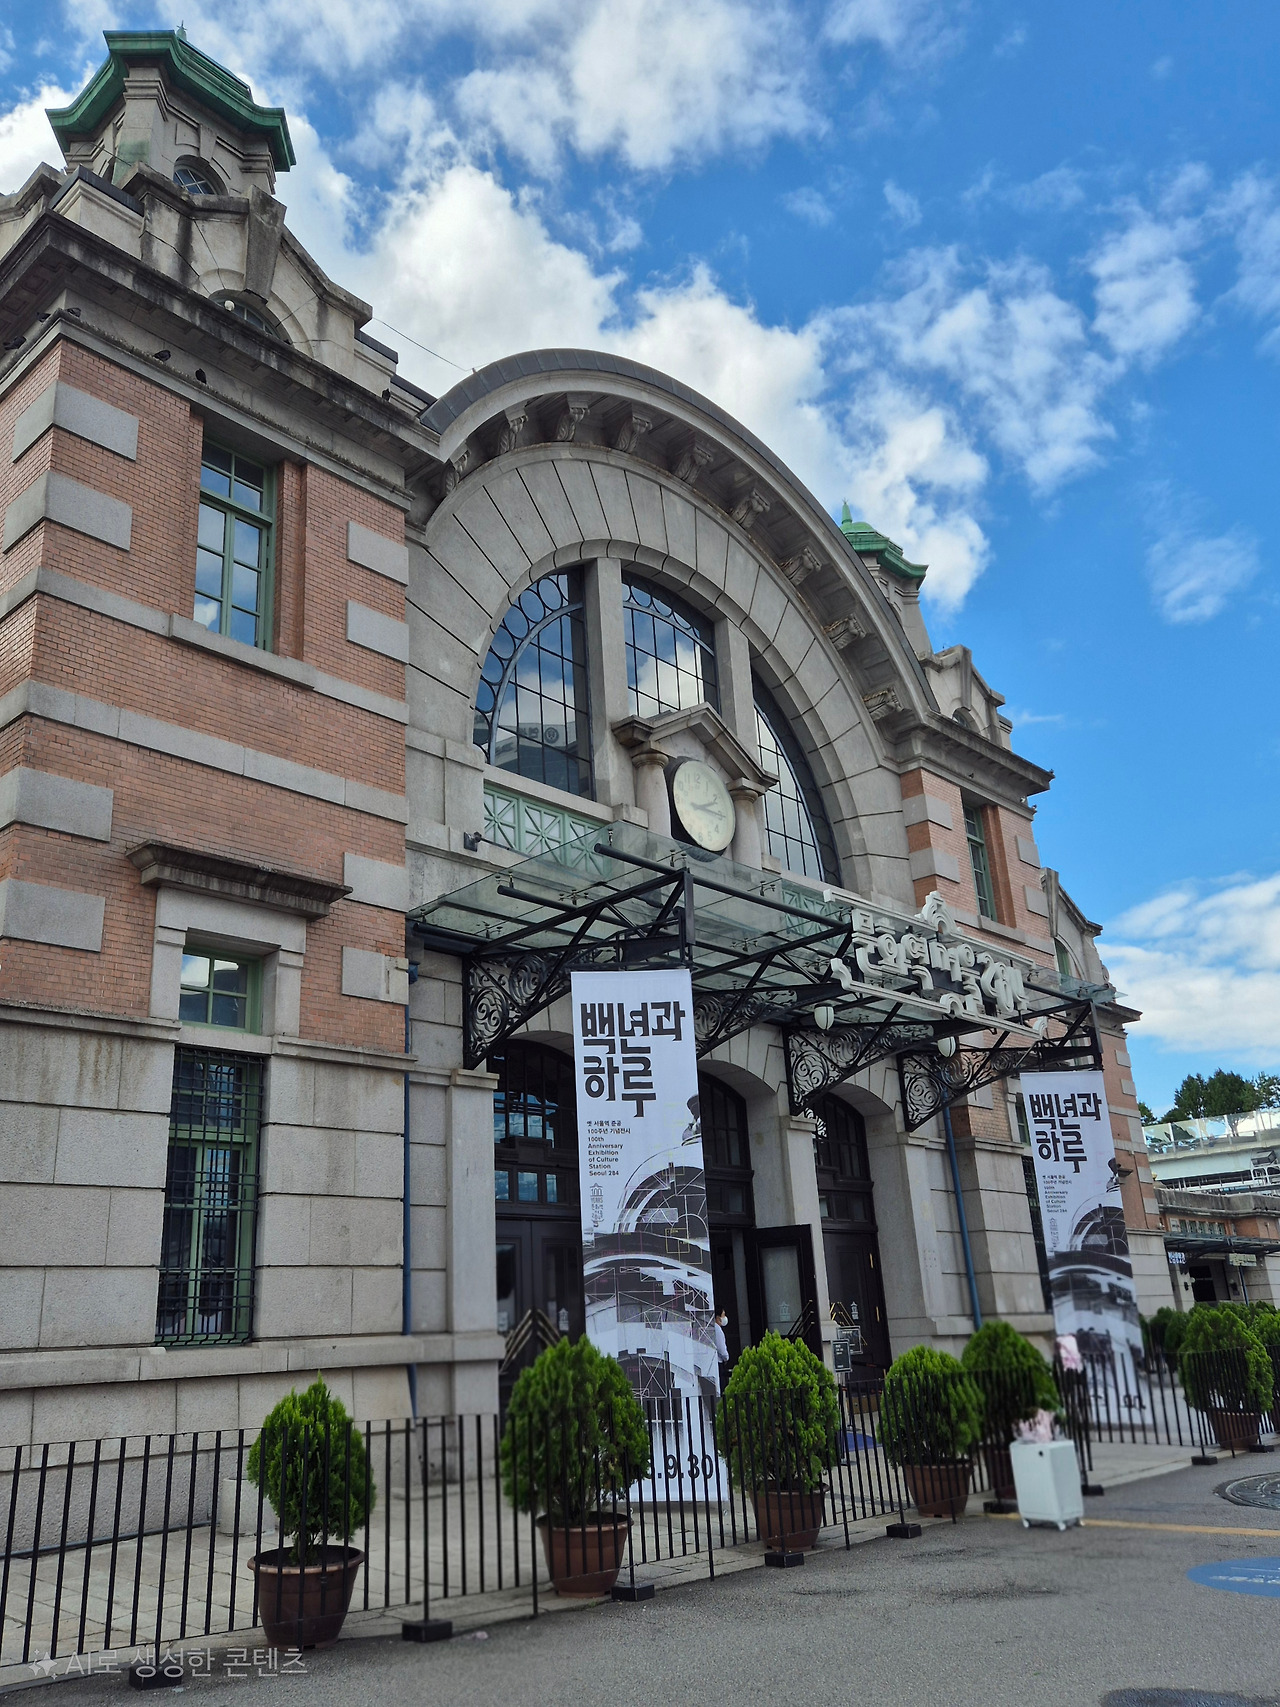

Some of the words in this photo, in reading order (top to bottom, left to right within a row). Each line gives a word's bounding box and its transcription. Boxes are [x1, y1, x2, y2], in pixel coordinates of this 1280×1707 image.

[580, 1001, 686, 1055] 백년과
[583, 1056, 657, 1118] 하루
[1029, 1092, 1103, 1130] 백년과
[1035, 1130, 1088, 1174] 하루
[643, 1454, 714, 1479] .9.30
